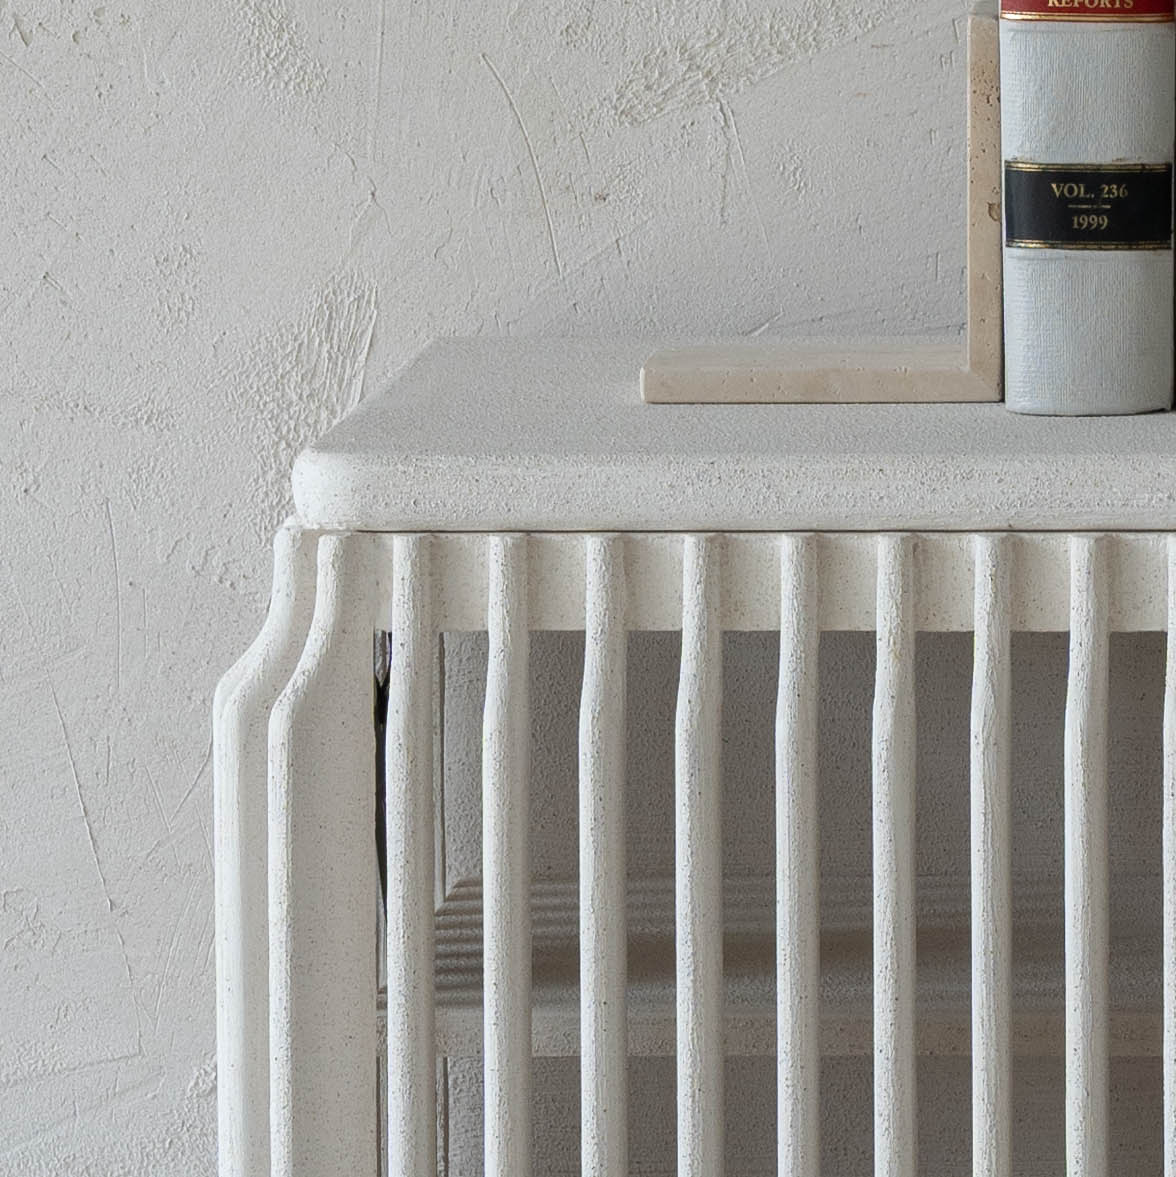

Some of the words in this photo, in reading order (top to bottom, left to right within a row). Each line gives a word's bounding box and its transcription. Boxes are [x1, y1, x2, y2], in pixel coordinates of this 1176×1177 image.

[1051, 183, 1095, 199] VOL.
[1099, 183, 1128, 199] 236
[1072, 214, 1108, 229] 1999
